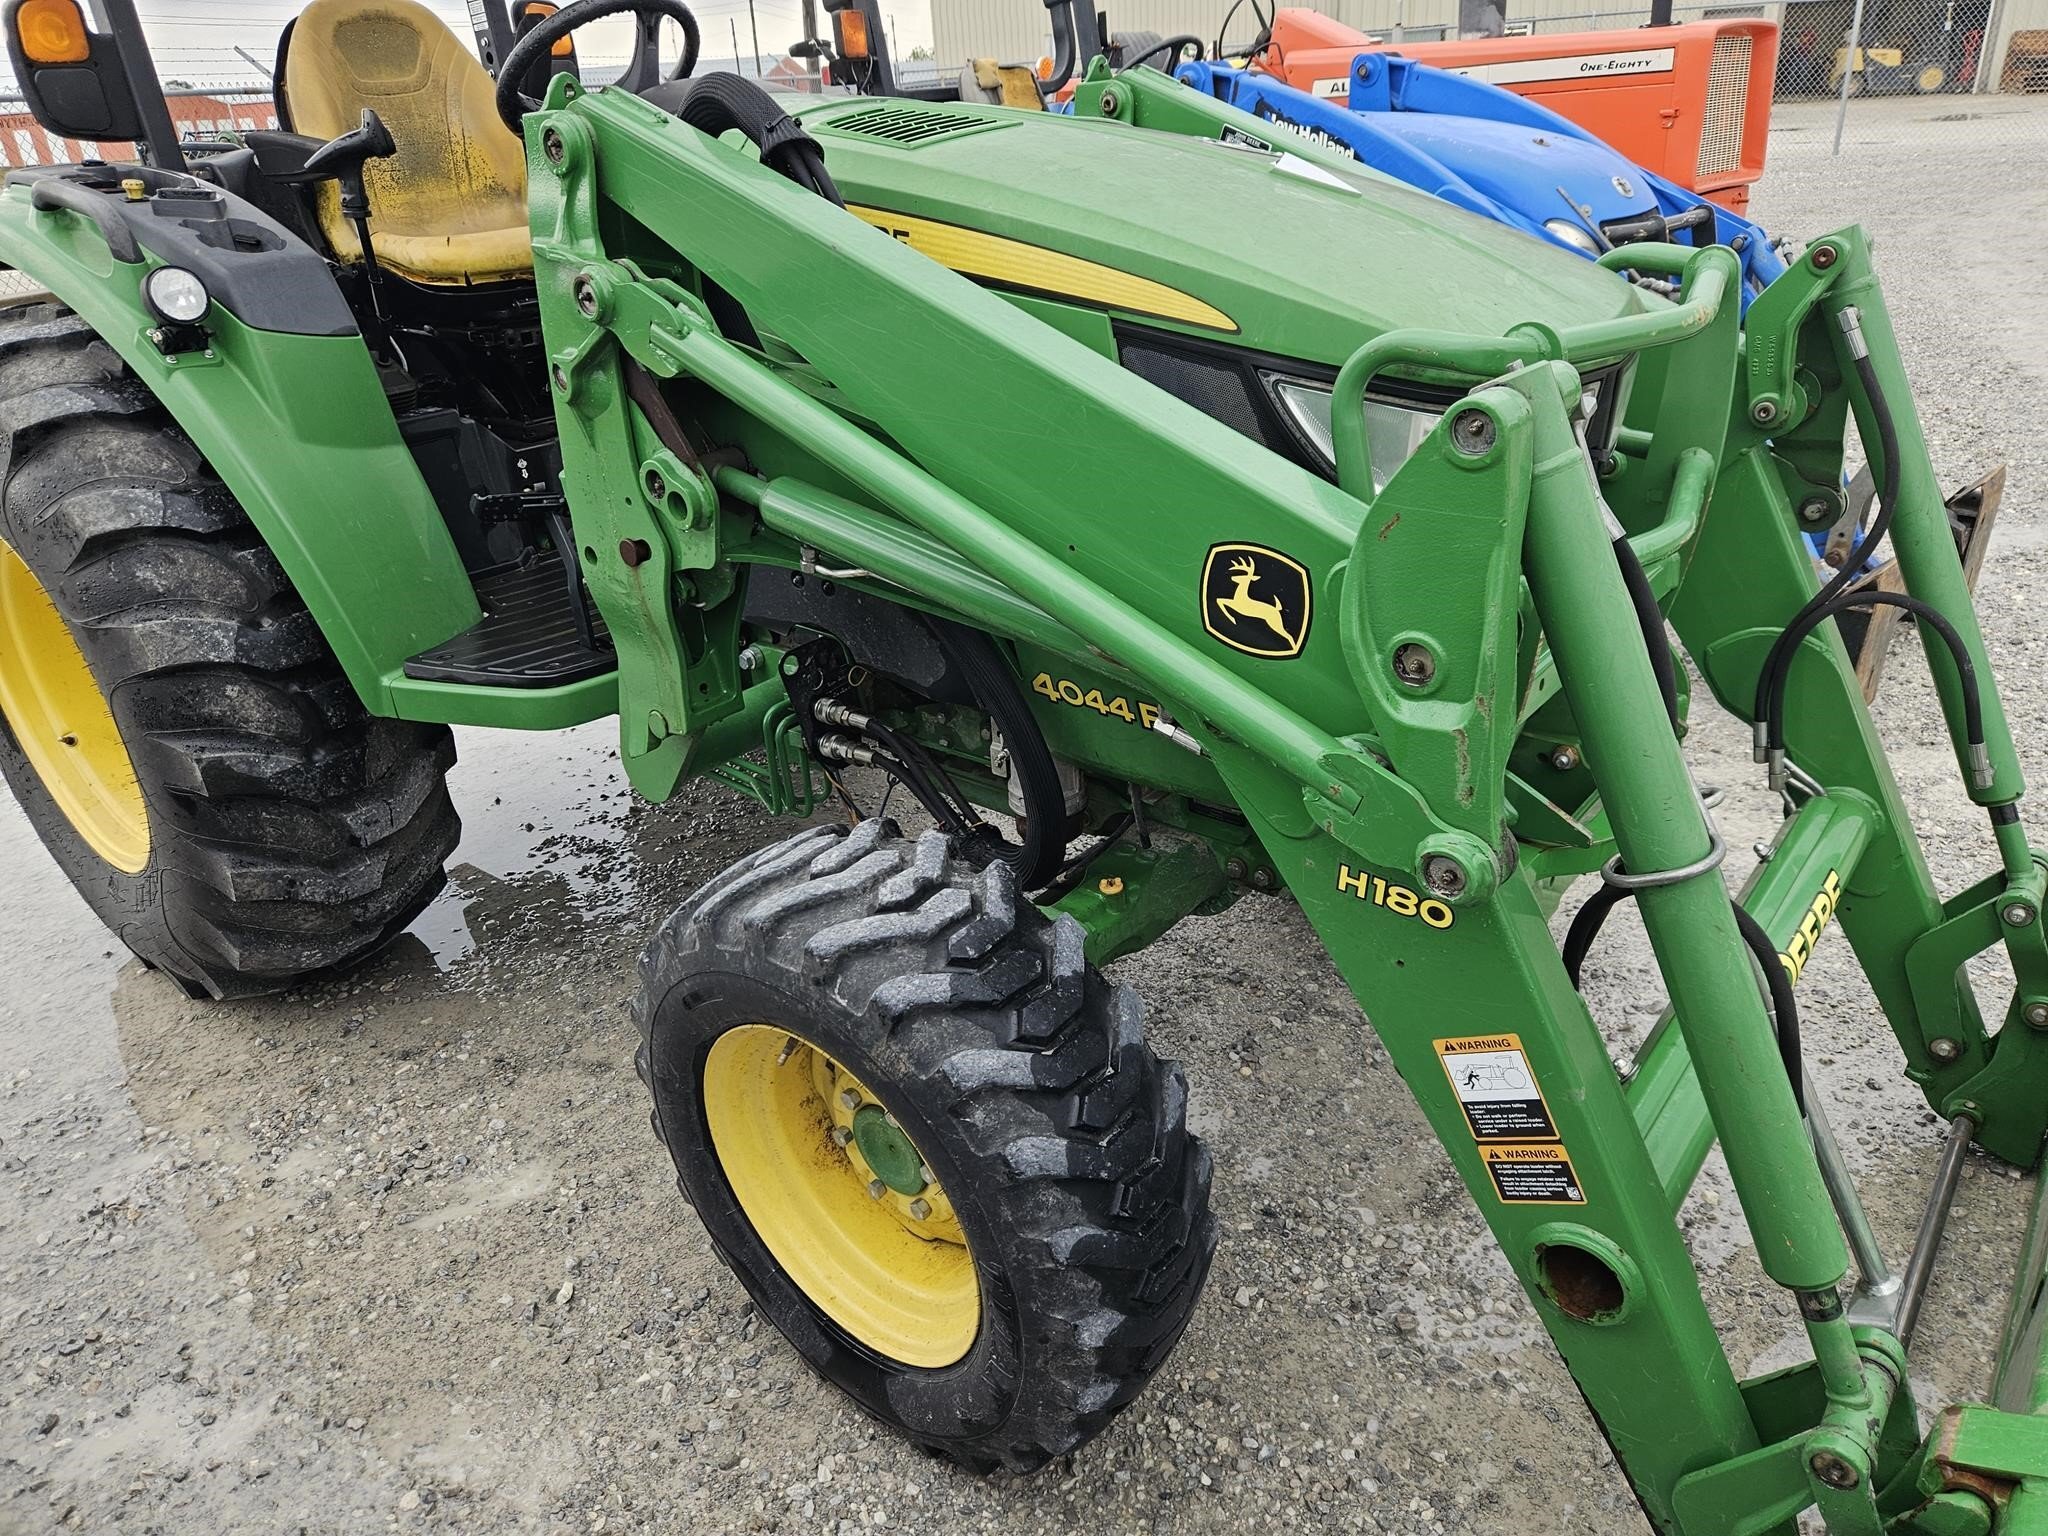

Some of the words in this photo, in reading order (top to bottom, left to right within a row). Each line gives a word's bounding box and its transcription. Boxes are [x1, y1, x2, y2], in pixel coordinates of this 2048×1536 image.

[1032, 672, 1136, 724] 4044
[1336, 863, 1455, 930] H180
[1456, 1039, 1511, 1051] WARNING
[1504, 1150, 1559, 1159] WARNING
